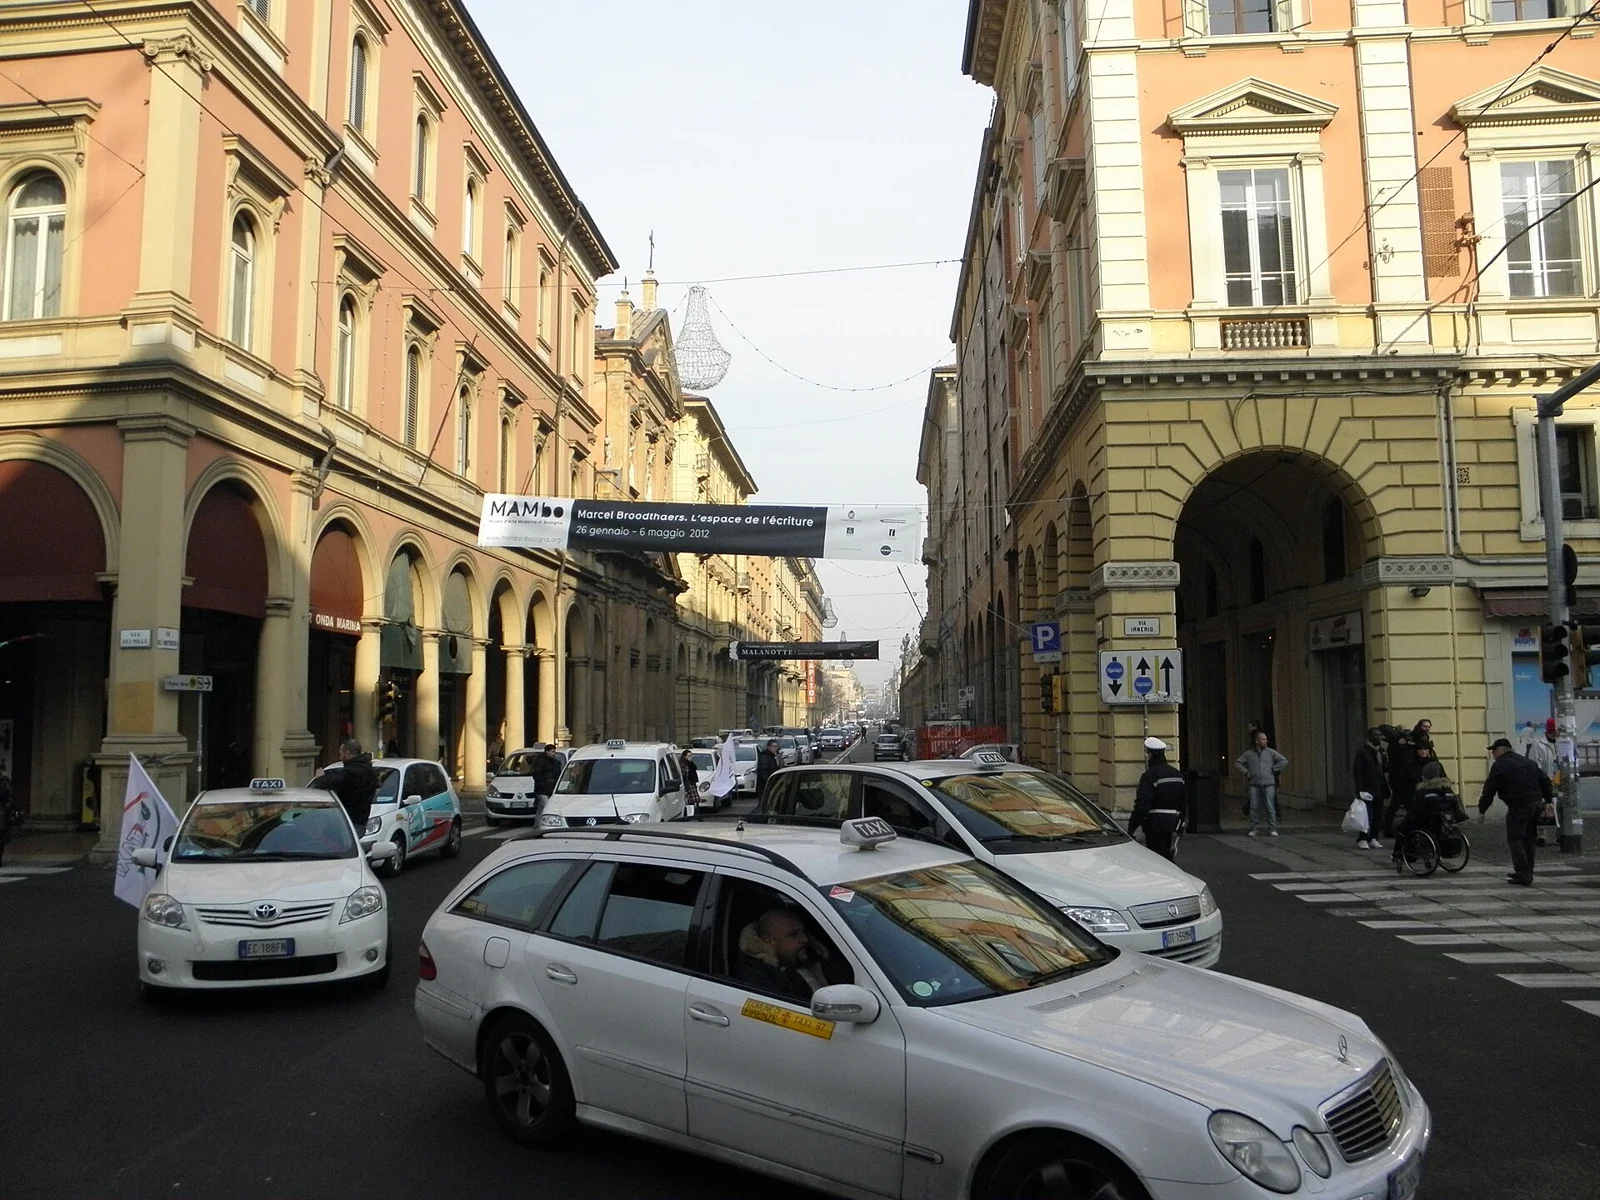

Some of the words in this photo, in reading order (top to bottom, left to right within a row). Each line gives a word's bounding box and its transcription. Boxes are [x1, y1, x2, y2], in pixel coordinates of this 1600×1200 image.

[490, 501, 564, 518] MAMbo
[577, 509, 614, 520] Marcel
[616, 510, 688, 522] Broodthaers.
[691, 514, 742, 525] L'espace
[744, 515, 759, 525] de
[762, 515, 814, 527] l'écriture
[575, 525, 587, 534] 26
[589, 526, 629, 537] gennaio
[639, 528, 645, 536] 6
[647, 529, 685, 540] maggio
[689, 529, 710, 539] 2012
[315, 613, 334, 628] ONDA
[336, 617, 361, 632] MARINA
[1036, 625, 1055, 650] P
[807, 660, 815, 703] APITOL
[980, 754, 1004, 762] TAXI
[254, 780, 281, 788] TAXI
[854, 820, 891, 836] TAXI
[745, 1009, 778, 1023] FIRENZE
[794, 1016, 812, 1028] TAXI
[815, 1022, 826, 1032] 97
